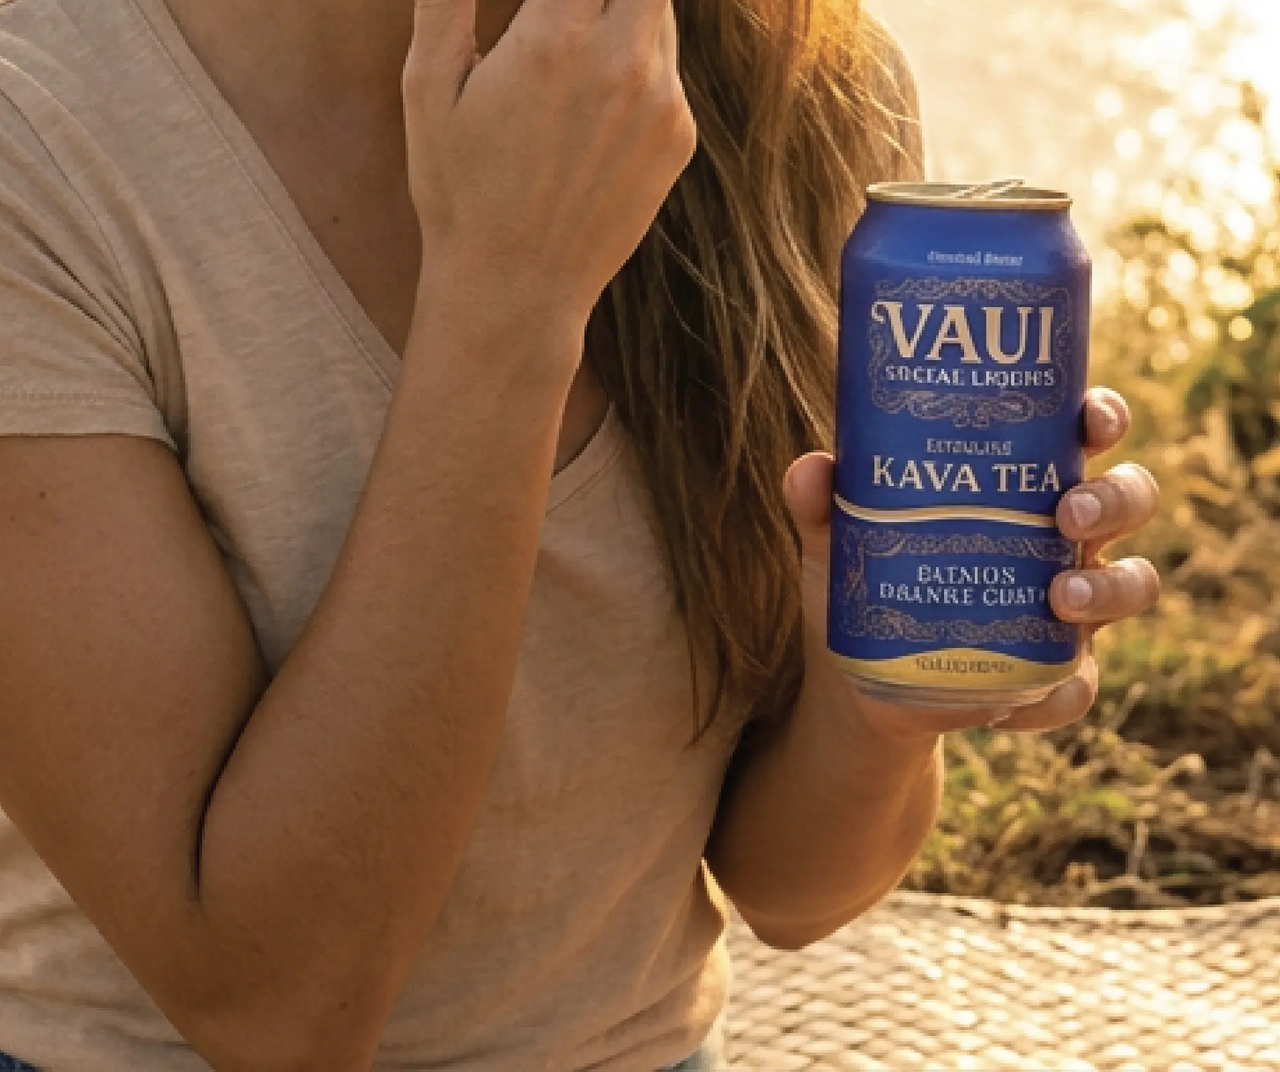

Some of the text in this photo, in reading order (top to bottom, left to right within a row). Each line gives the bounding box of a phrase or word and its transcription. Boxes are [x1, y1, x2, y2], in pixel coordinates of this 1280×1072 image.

[872, 301, 1054, 364] VAUI
[873, 454, 1061, 492] KAVA TEA
